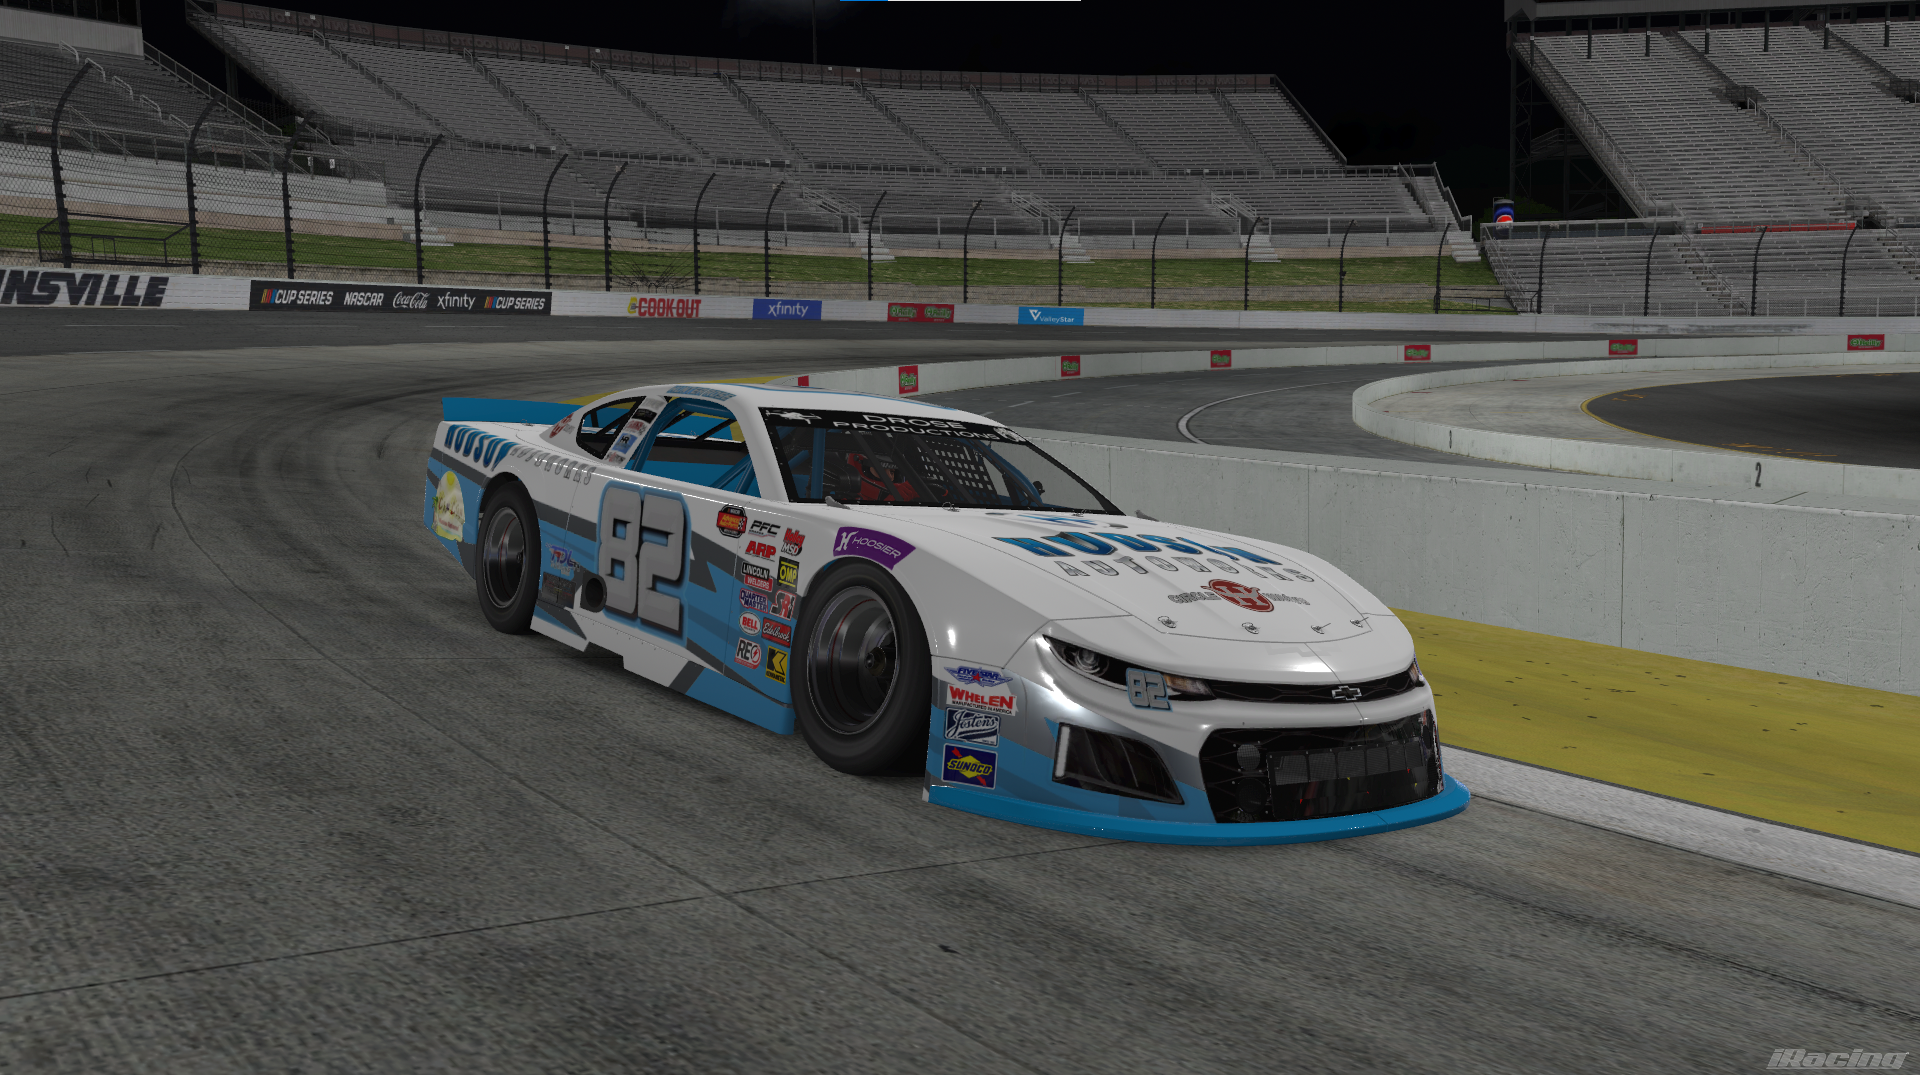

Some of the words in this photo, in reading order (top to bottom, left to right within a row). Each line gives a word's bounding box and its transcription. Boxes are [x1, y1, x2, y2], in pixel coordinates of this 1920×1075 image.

[275, 289, 296, 305] CUP
[297, 290, 334, 306] SERIES
[344, 291, 384, 306] NASCAR
[436, 291, 476, 310] xfinity
[496, 296, 515, 309] CUP
[515, 297, 546, 310] SERIES
[767, 301, 808, 317] xfinity
[862, 414, 968, 430] DROSE
[832, 421, 1001, 441] PRODUCTIONS
[1755, 461, 1763, 488] 2
[750, 519, 781, 535] PFC
[745, 540, 777, 558] ARP
[781, 542, 799, 556] MSD
[851, 537, 901, 559] HOOSIER
[598, 484, 688, 634] 82
[743, 563, 769, 580] LINCOLN
[779, 565, 797, 583] OMP
[747, 576, 770, 590] WELDERS
[740, 590, 766, 605] QUARTER
[744, 597, 767, 612] MASTER
[742, 616, 758, 630] BELL
[957, 667, 976, 675] FIVE
[949, 685, 1014, 710] WHELEN
[1127, 669, 1171, 711] 82
[952, 700, 987, 711] MANUFACTURED
[992, 706, 1012, 715] AMERICA
[946, 708, 996, 739] Jostens
[949, 760, 992, 774] SUNOCO
